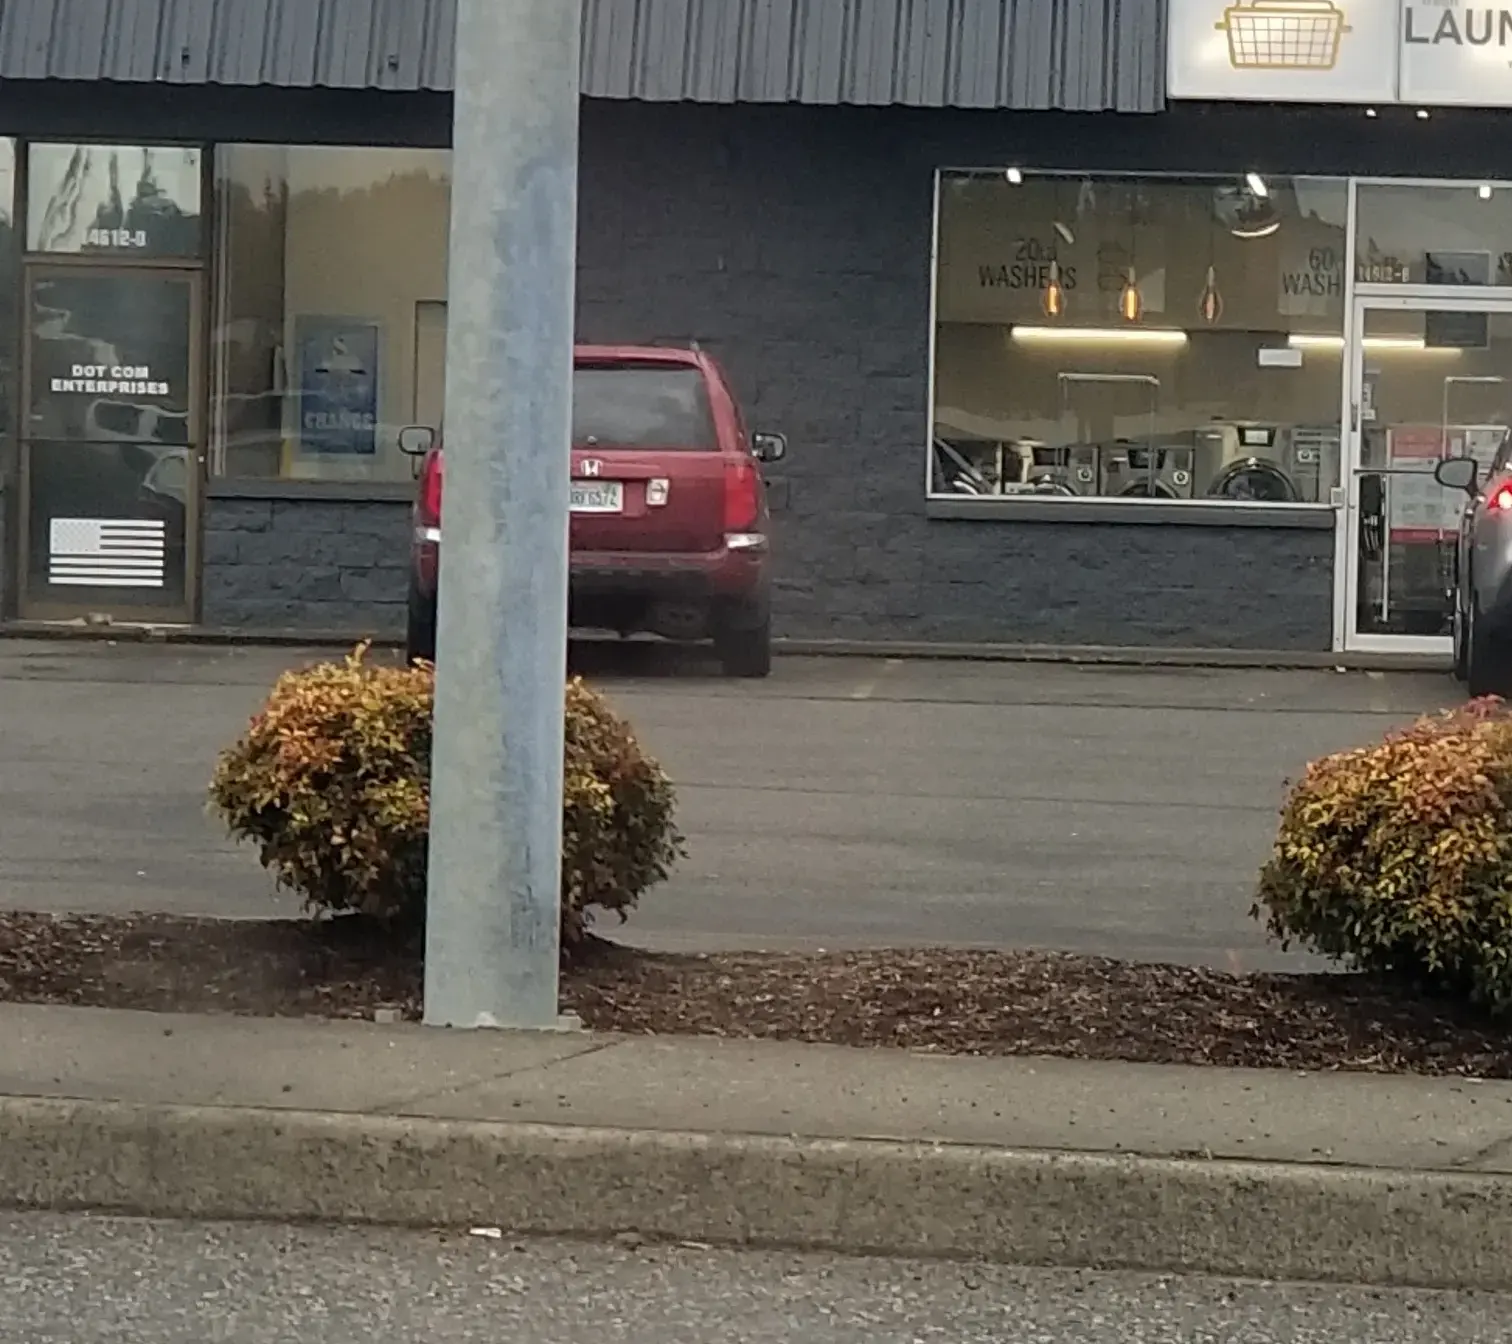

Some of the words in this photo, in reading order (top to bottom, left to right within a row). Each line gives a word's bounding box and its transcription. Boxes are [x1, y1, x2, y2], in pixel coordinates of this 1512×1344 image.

[71, 364, 106, 377] DOT
[111, 365, 149, 378] COM
[50, 378, 168, 394] ENTERPRISES
